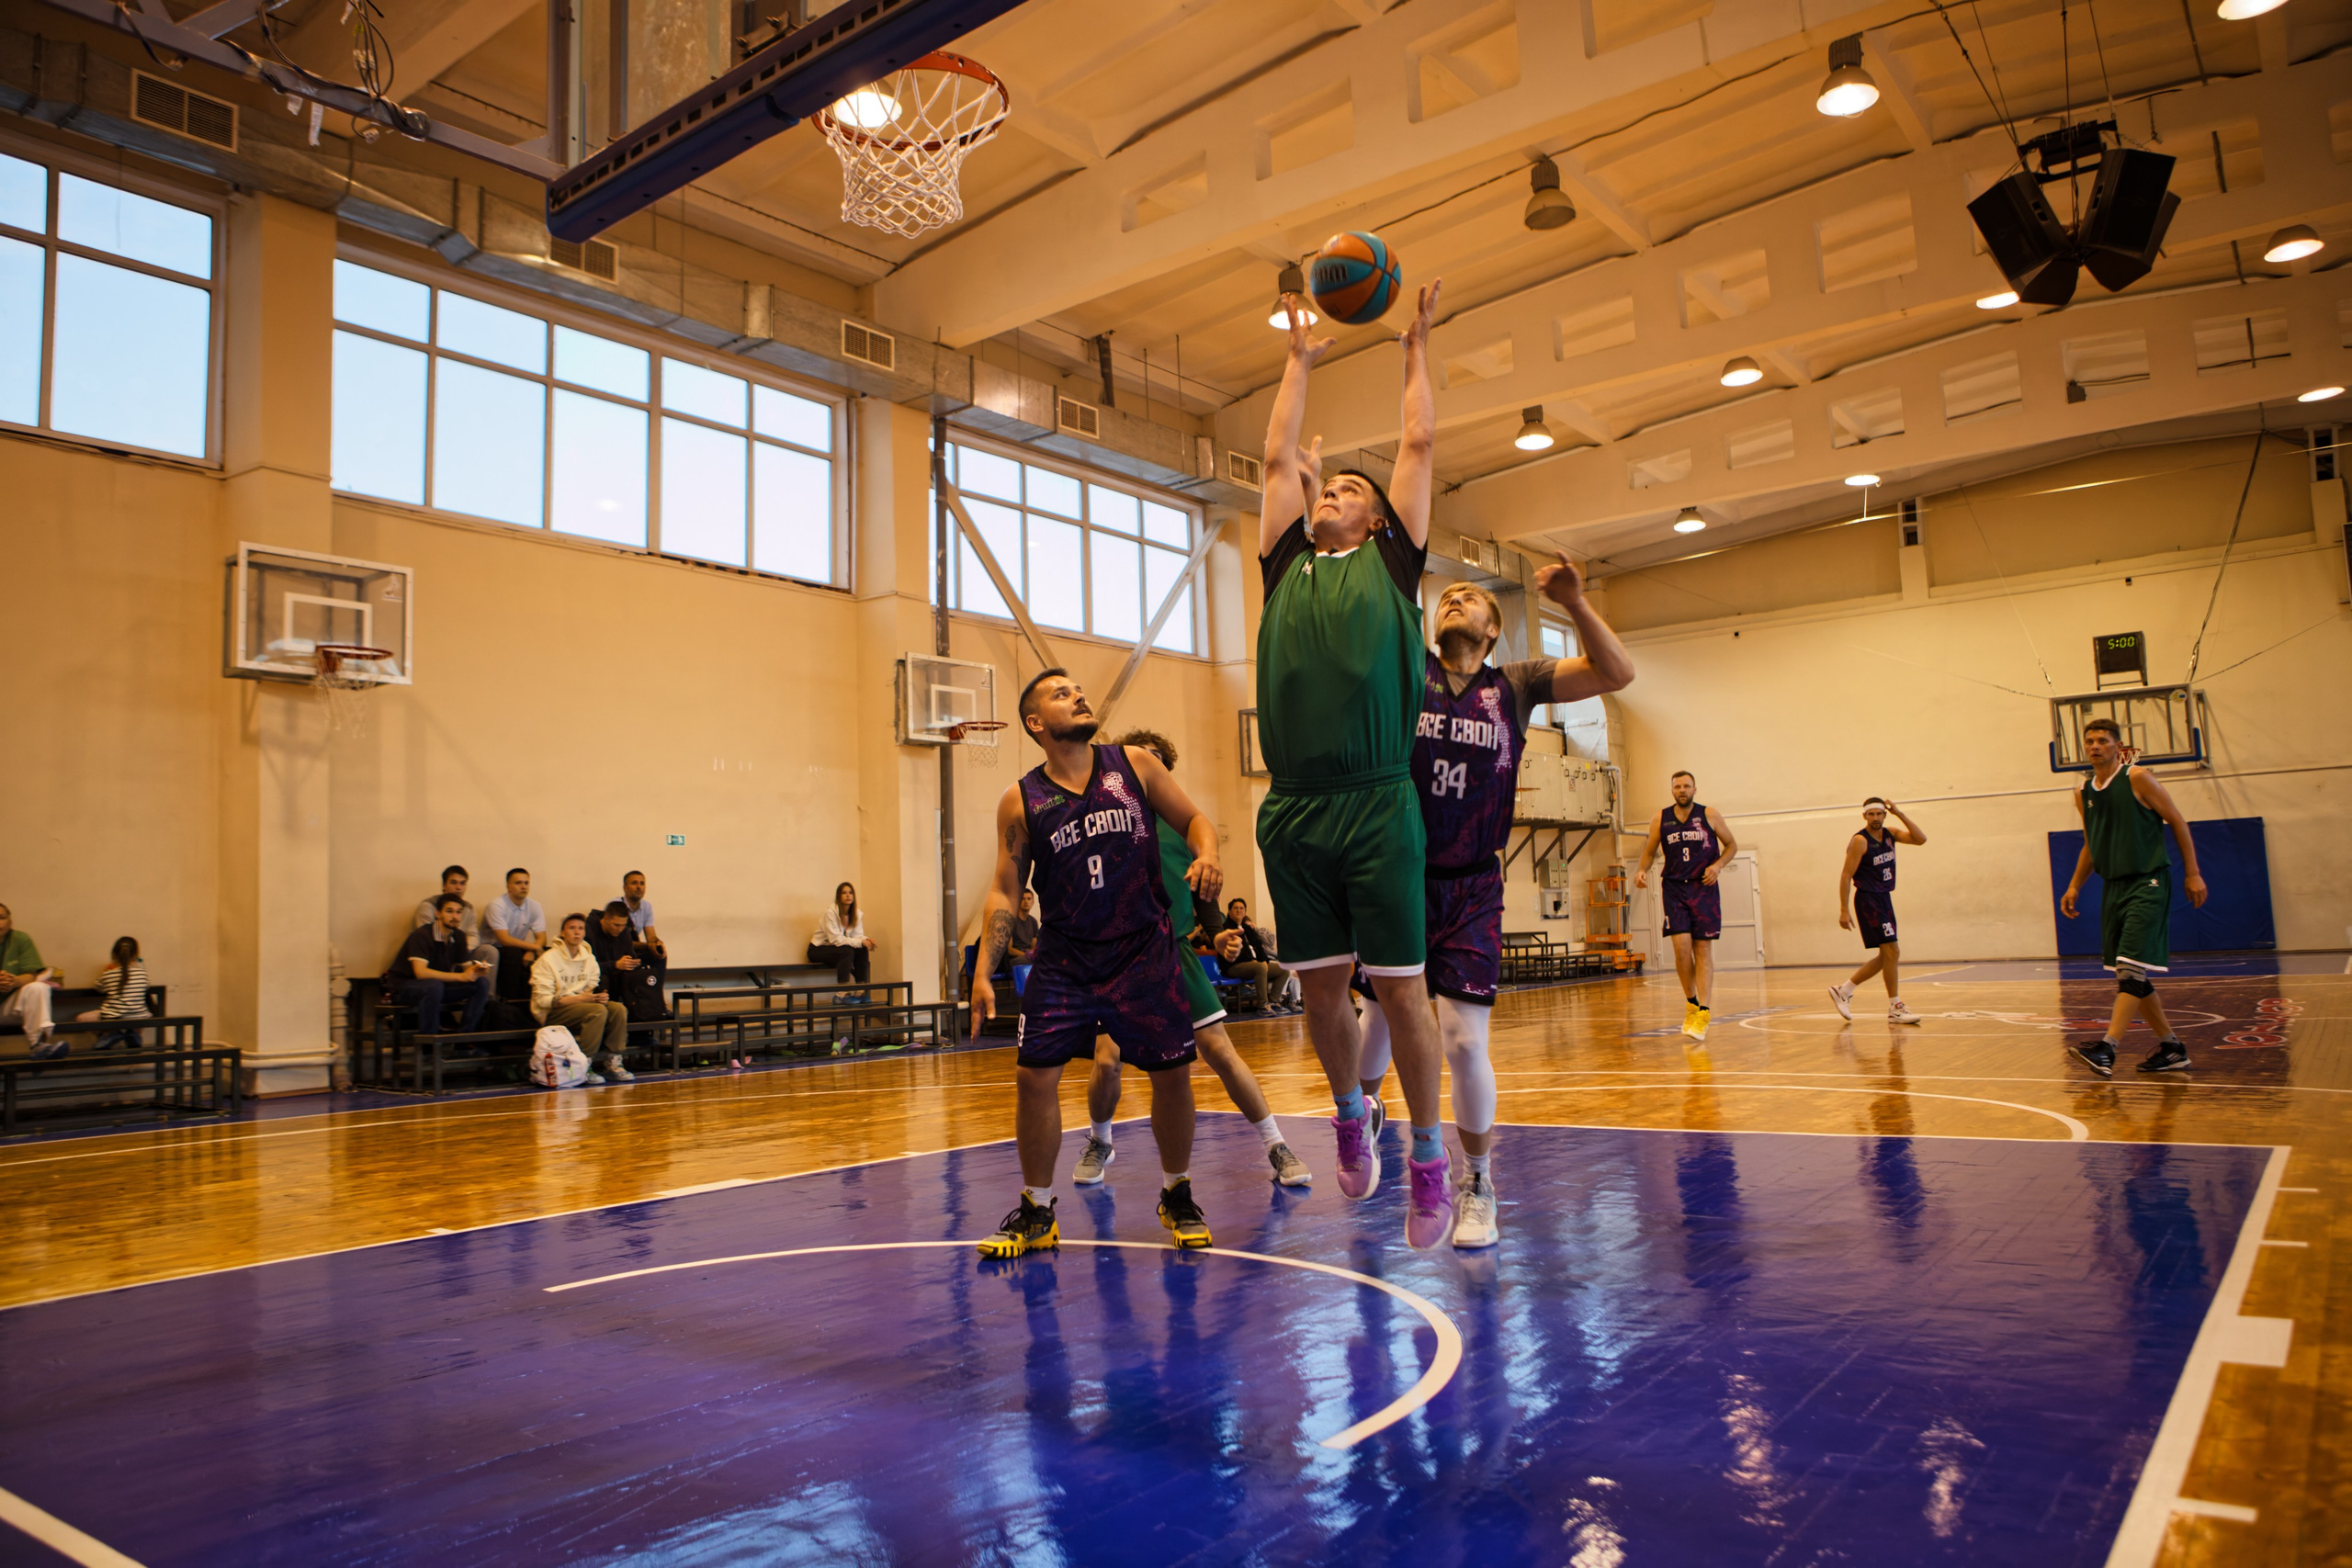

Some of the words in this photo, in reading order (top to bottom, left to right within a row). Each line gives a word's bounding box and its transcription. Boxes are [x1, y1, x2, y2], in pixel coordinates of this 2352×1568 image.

[2108, 636, 2135, 650] 5:00
[1416, 712, 1447, 739] ВСЕ
[1431, 758, 1467, 800] 34
[1049, 819, 1081, 854] ВСЕ
[1682, 847, 1690, 862] 3
[1087, 854, 1105, 890] 9
[1883, 867, 1893, 882] 26
[1882, 922, 1894, 937] 26
